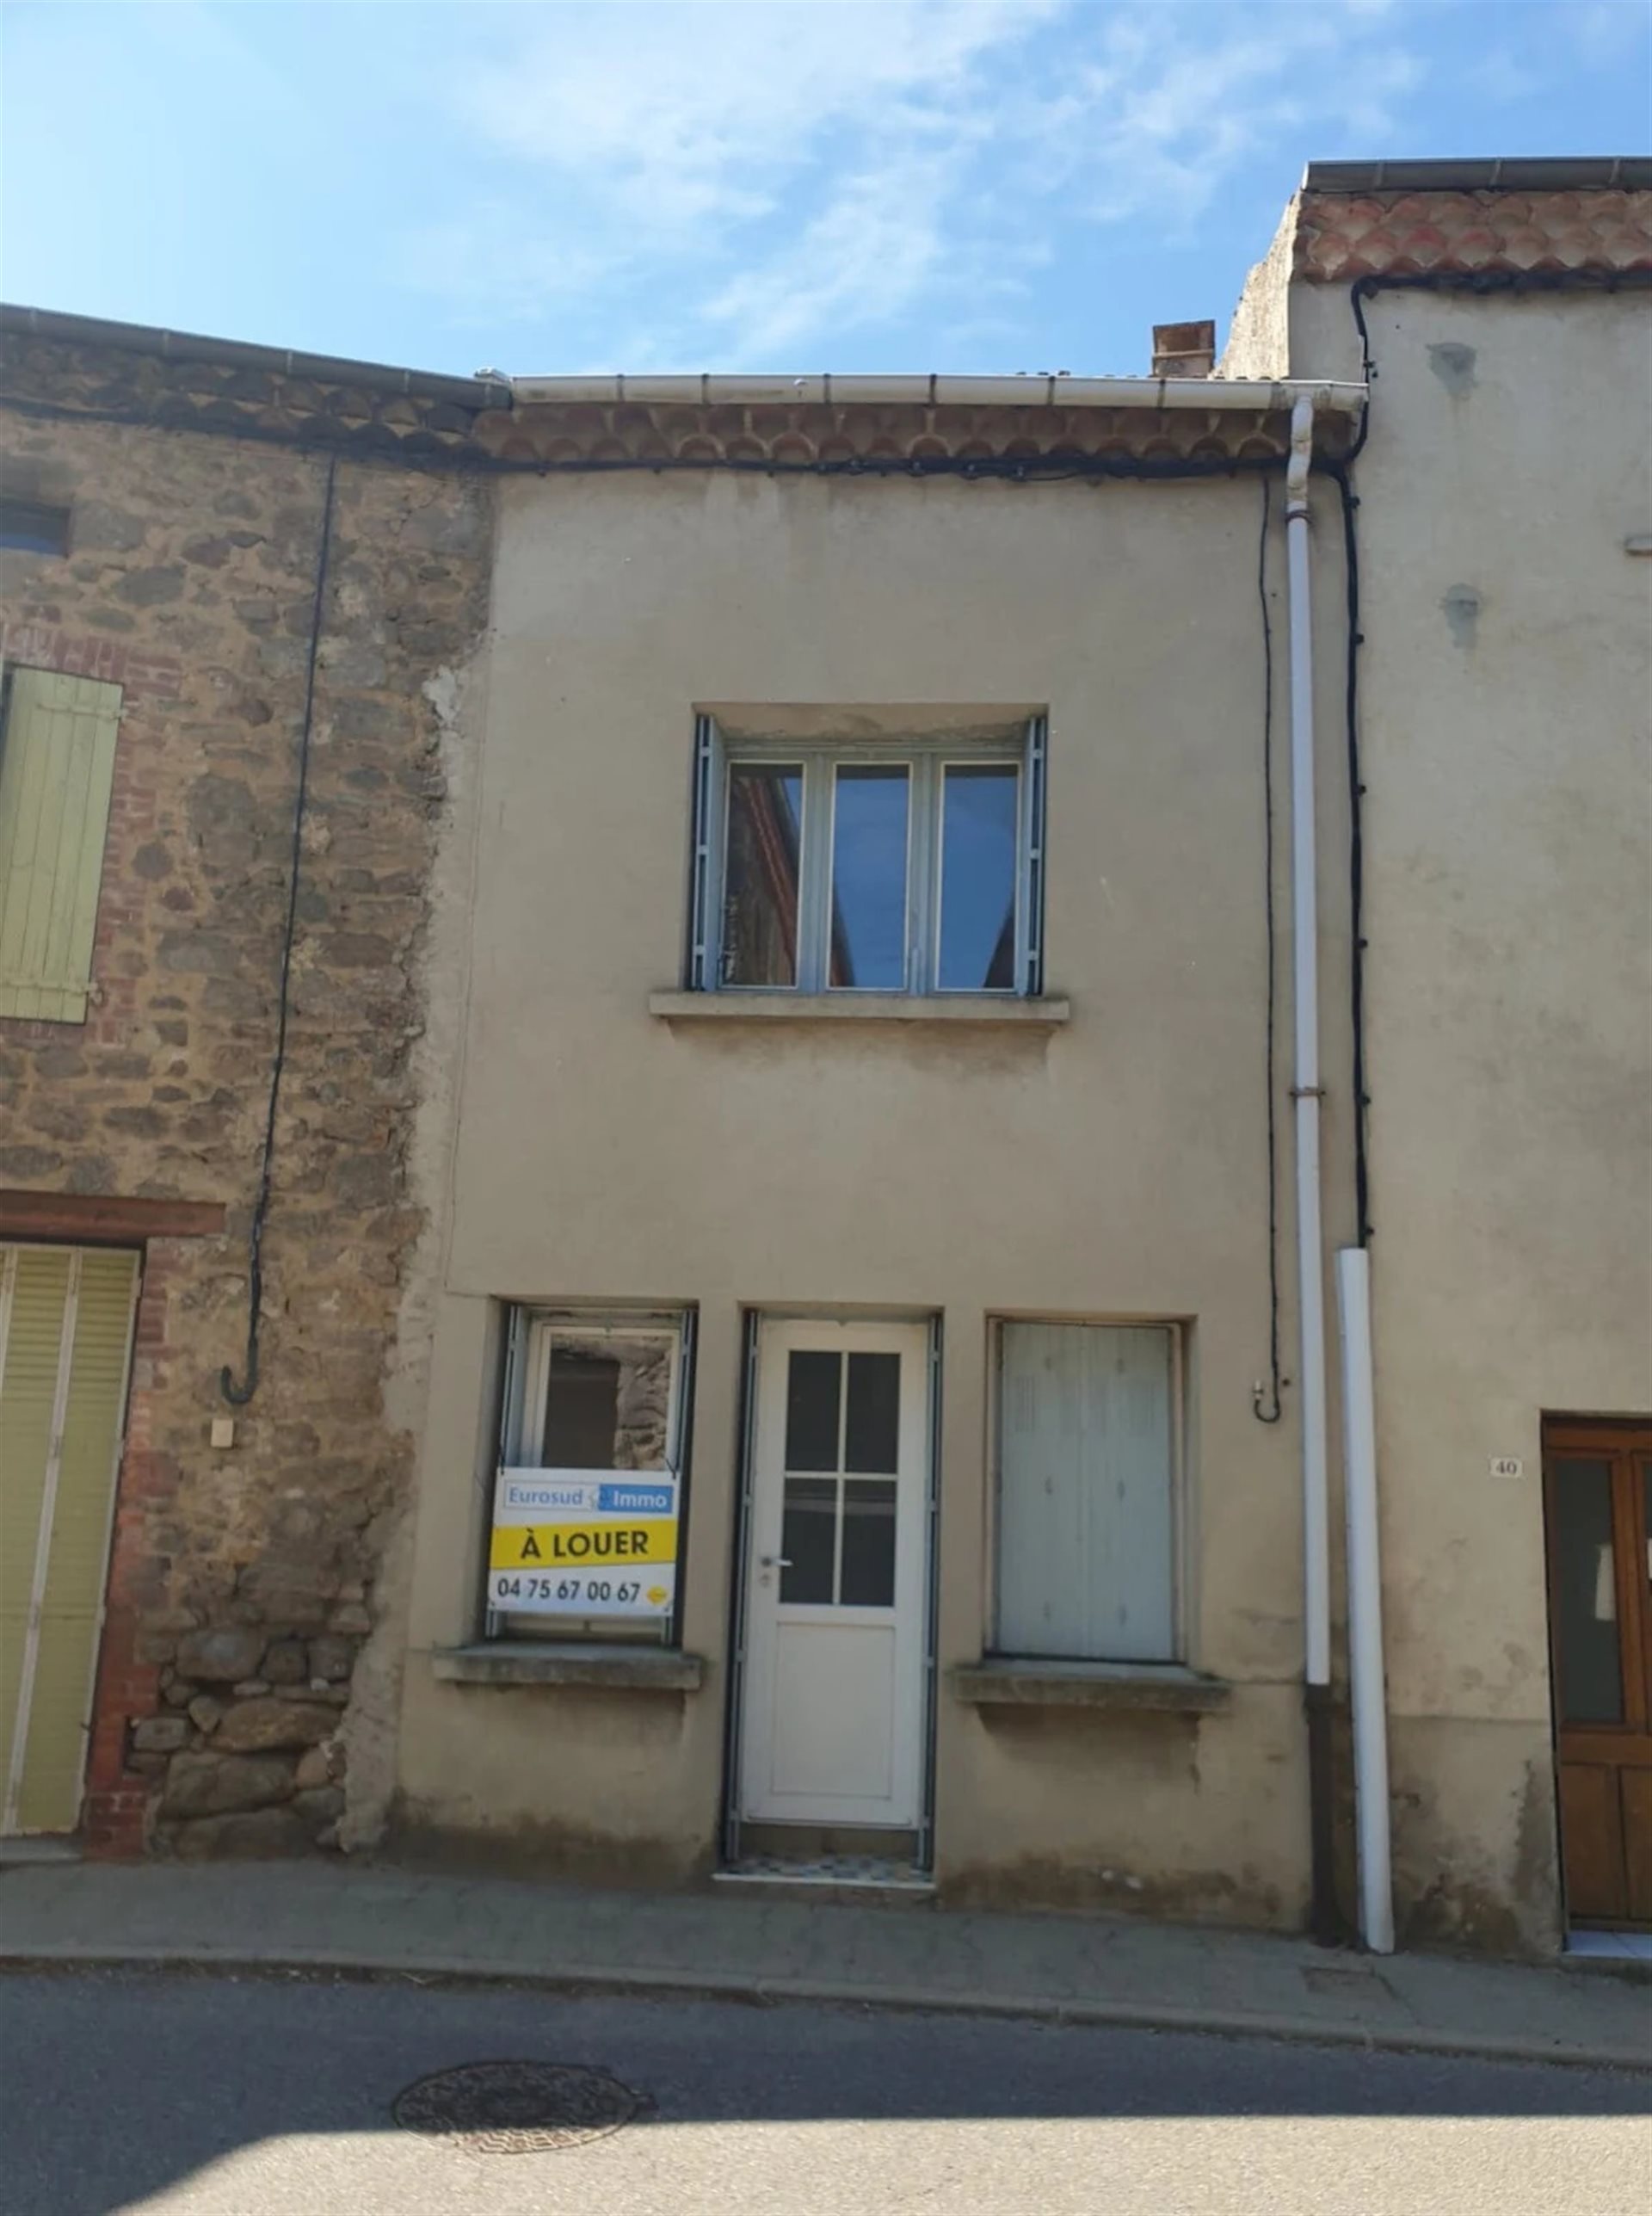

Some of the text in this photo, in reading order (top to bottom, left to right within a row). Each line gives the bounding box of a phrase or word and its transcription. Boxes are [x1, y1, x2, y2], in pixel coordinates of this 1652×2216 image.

[1496, 1461, 1517, 1473] 40
[509, 1487, 668, 1508] Eurosud Immo
[521, 1528, 649, 1559] À LOUER
[497, 1578, 521, 1597] 04
[527, 1579, 551, 1599] 75
[557, 1581, 581, 1601] 67
[587, 1582, 611, 1602] 00
[617, 1583, 641, 1602] 67
